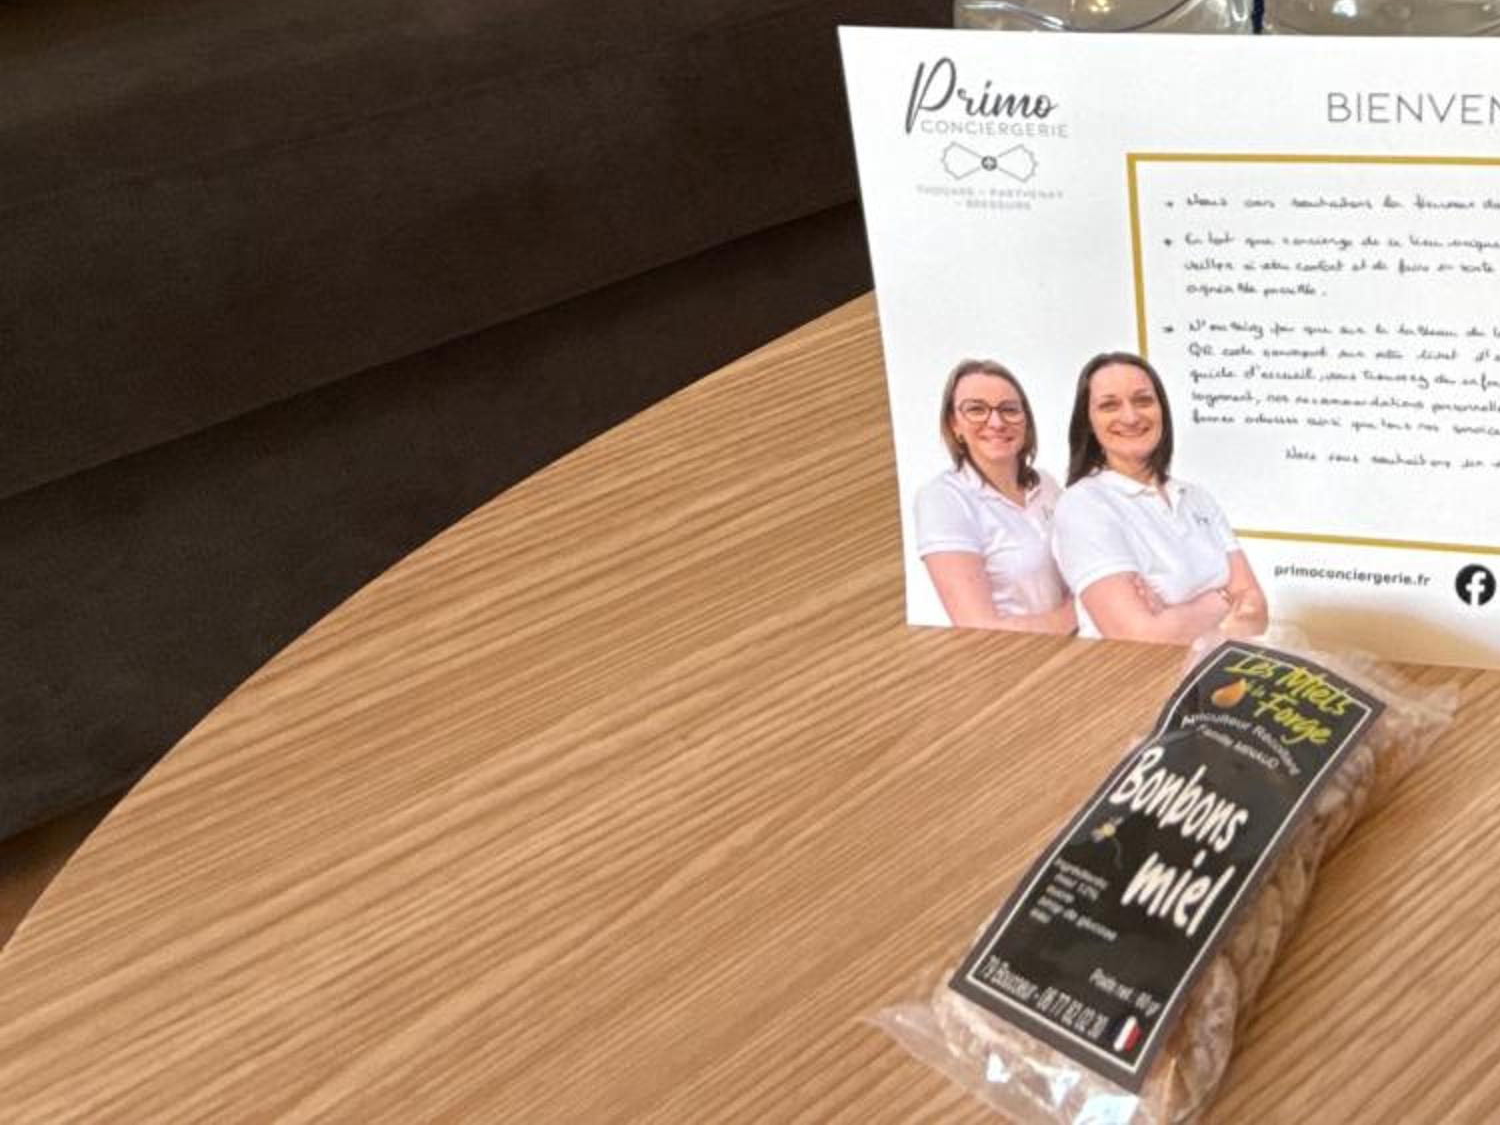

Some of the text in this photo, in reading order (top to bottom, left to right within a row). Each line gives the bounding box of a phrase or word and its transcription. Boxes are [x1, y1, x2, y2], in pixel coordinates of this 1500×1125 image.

[904, 56, 1060, 135] Primo
[920, 119, 1069, 139] CONCIERGERIE
[1188, 342, 1216, 358] QR
[1295, 395, 1426, 410] recommandations
[1273, 563, 1432, 587] primoconciergerie.fr
[1223, 651, 1281, 678] Les
[1252, 690, 1333, 746] Forge
[1108, 745, 1249, 853] Bonbons
[1119, 849, 1237, 938] miel
